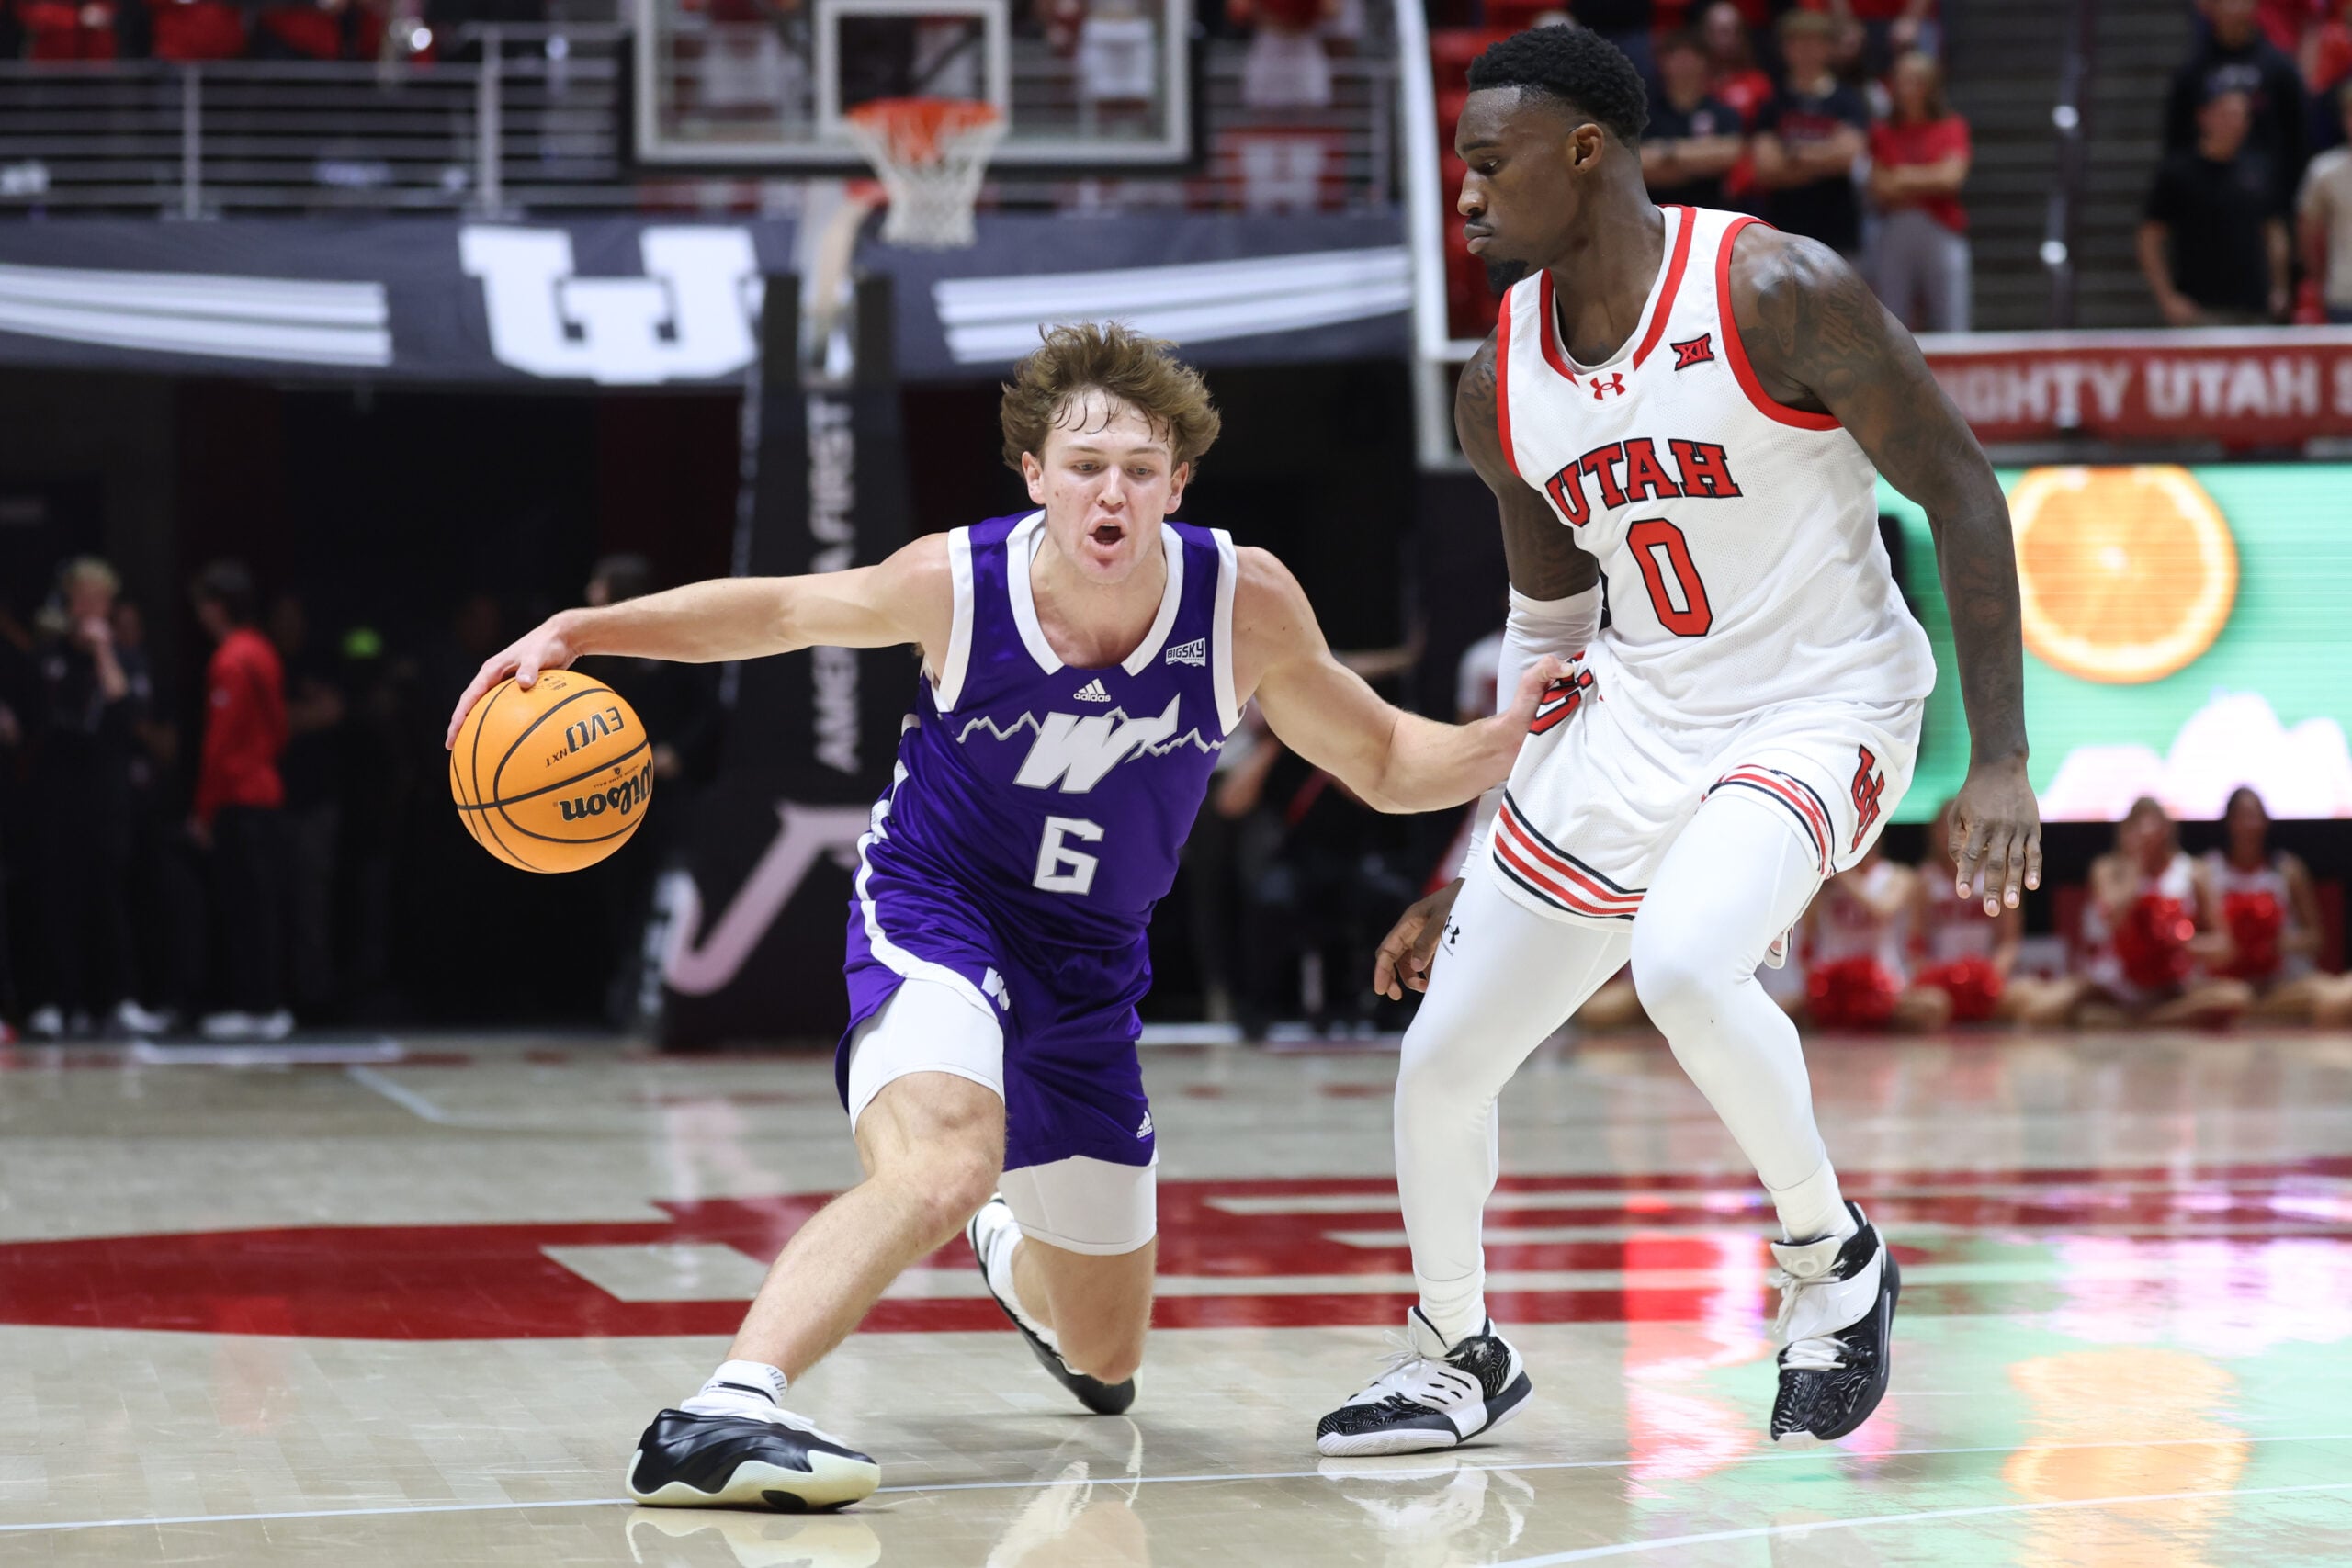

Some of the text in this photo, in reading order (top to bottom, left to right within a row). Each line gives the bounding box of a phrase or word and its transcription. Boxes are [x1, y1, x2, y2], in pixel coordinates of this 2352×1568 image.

[2143, 356, 2321, 419] UTAH
[808, 396, 856, 543] FIRST
[1544, 437, 1744, 528] UTAH
[1626, 517, 1713, 637] 0
[1073, 693, 1112, 703] adidas
[545, 748, 568, 768] NXT
[559, 758, 653, 821] Wilson
[1032, 815, 1105, 897] 6
